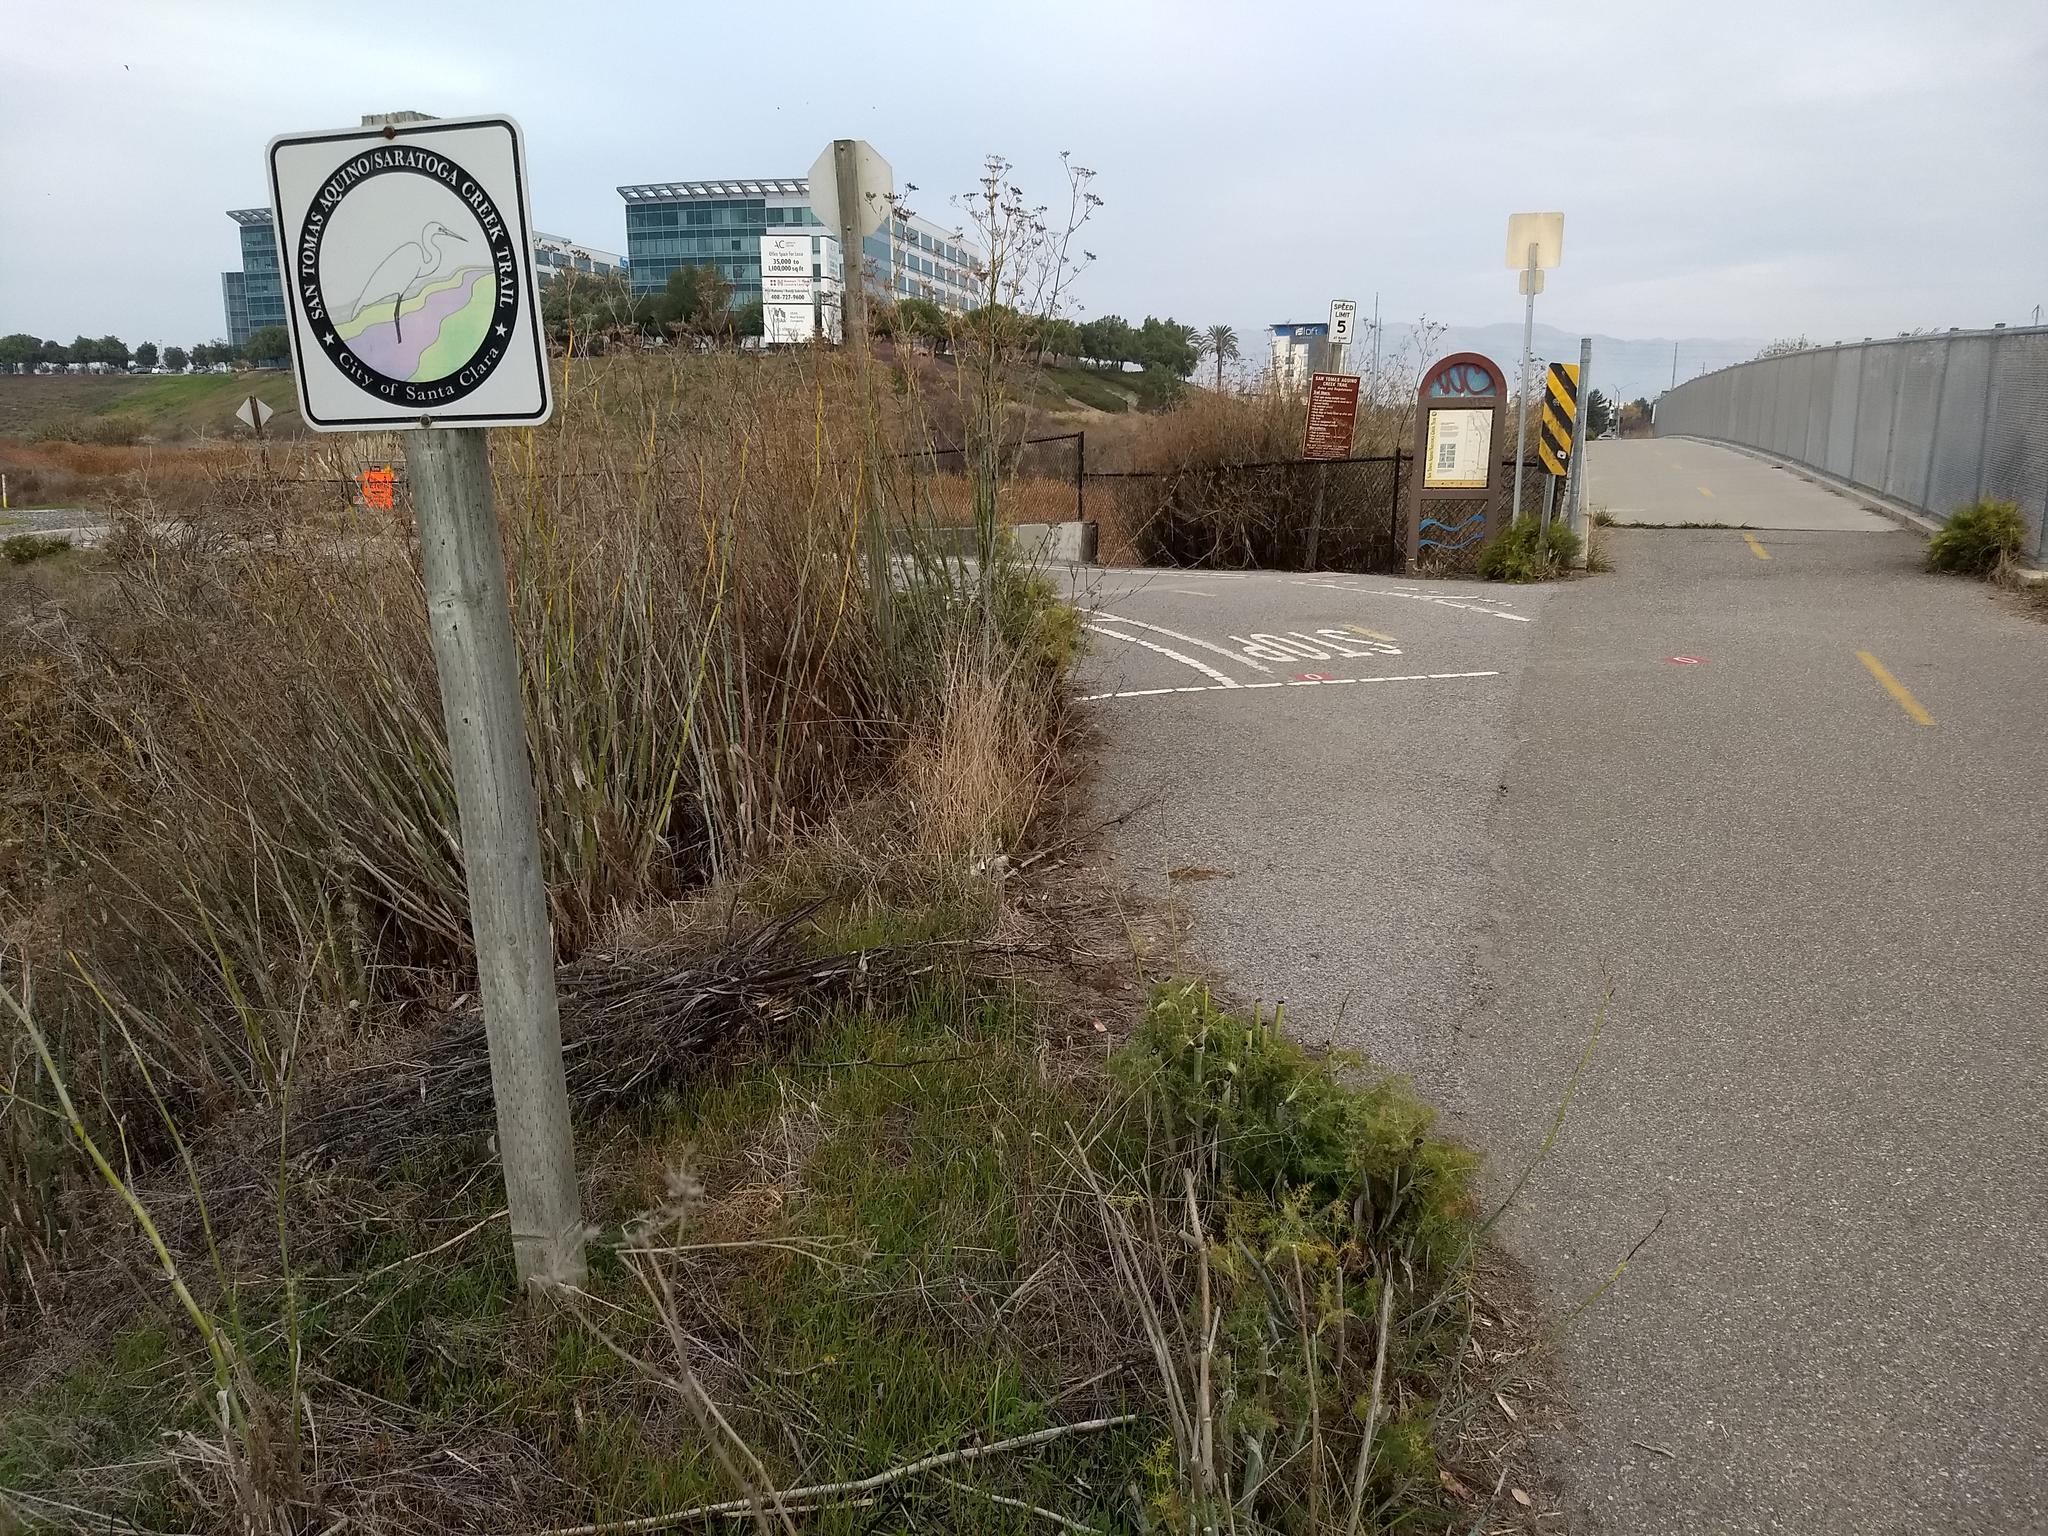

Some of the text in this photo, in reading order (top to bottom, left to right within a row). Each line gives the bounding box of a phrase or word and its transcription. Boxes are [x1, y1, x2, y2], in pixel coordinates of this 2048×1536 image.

[302, 150, 515, 320] SAN TOMAS AQUINO/SARATOGA CREEK TRAIL
[1334, 303, 1353, 311] SPEED
[1337, 320, 1346, 333] 5
[338, 347, 499, 402] City of Santa Clara
[1227, 628, 1403, 662] STOP
